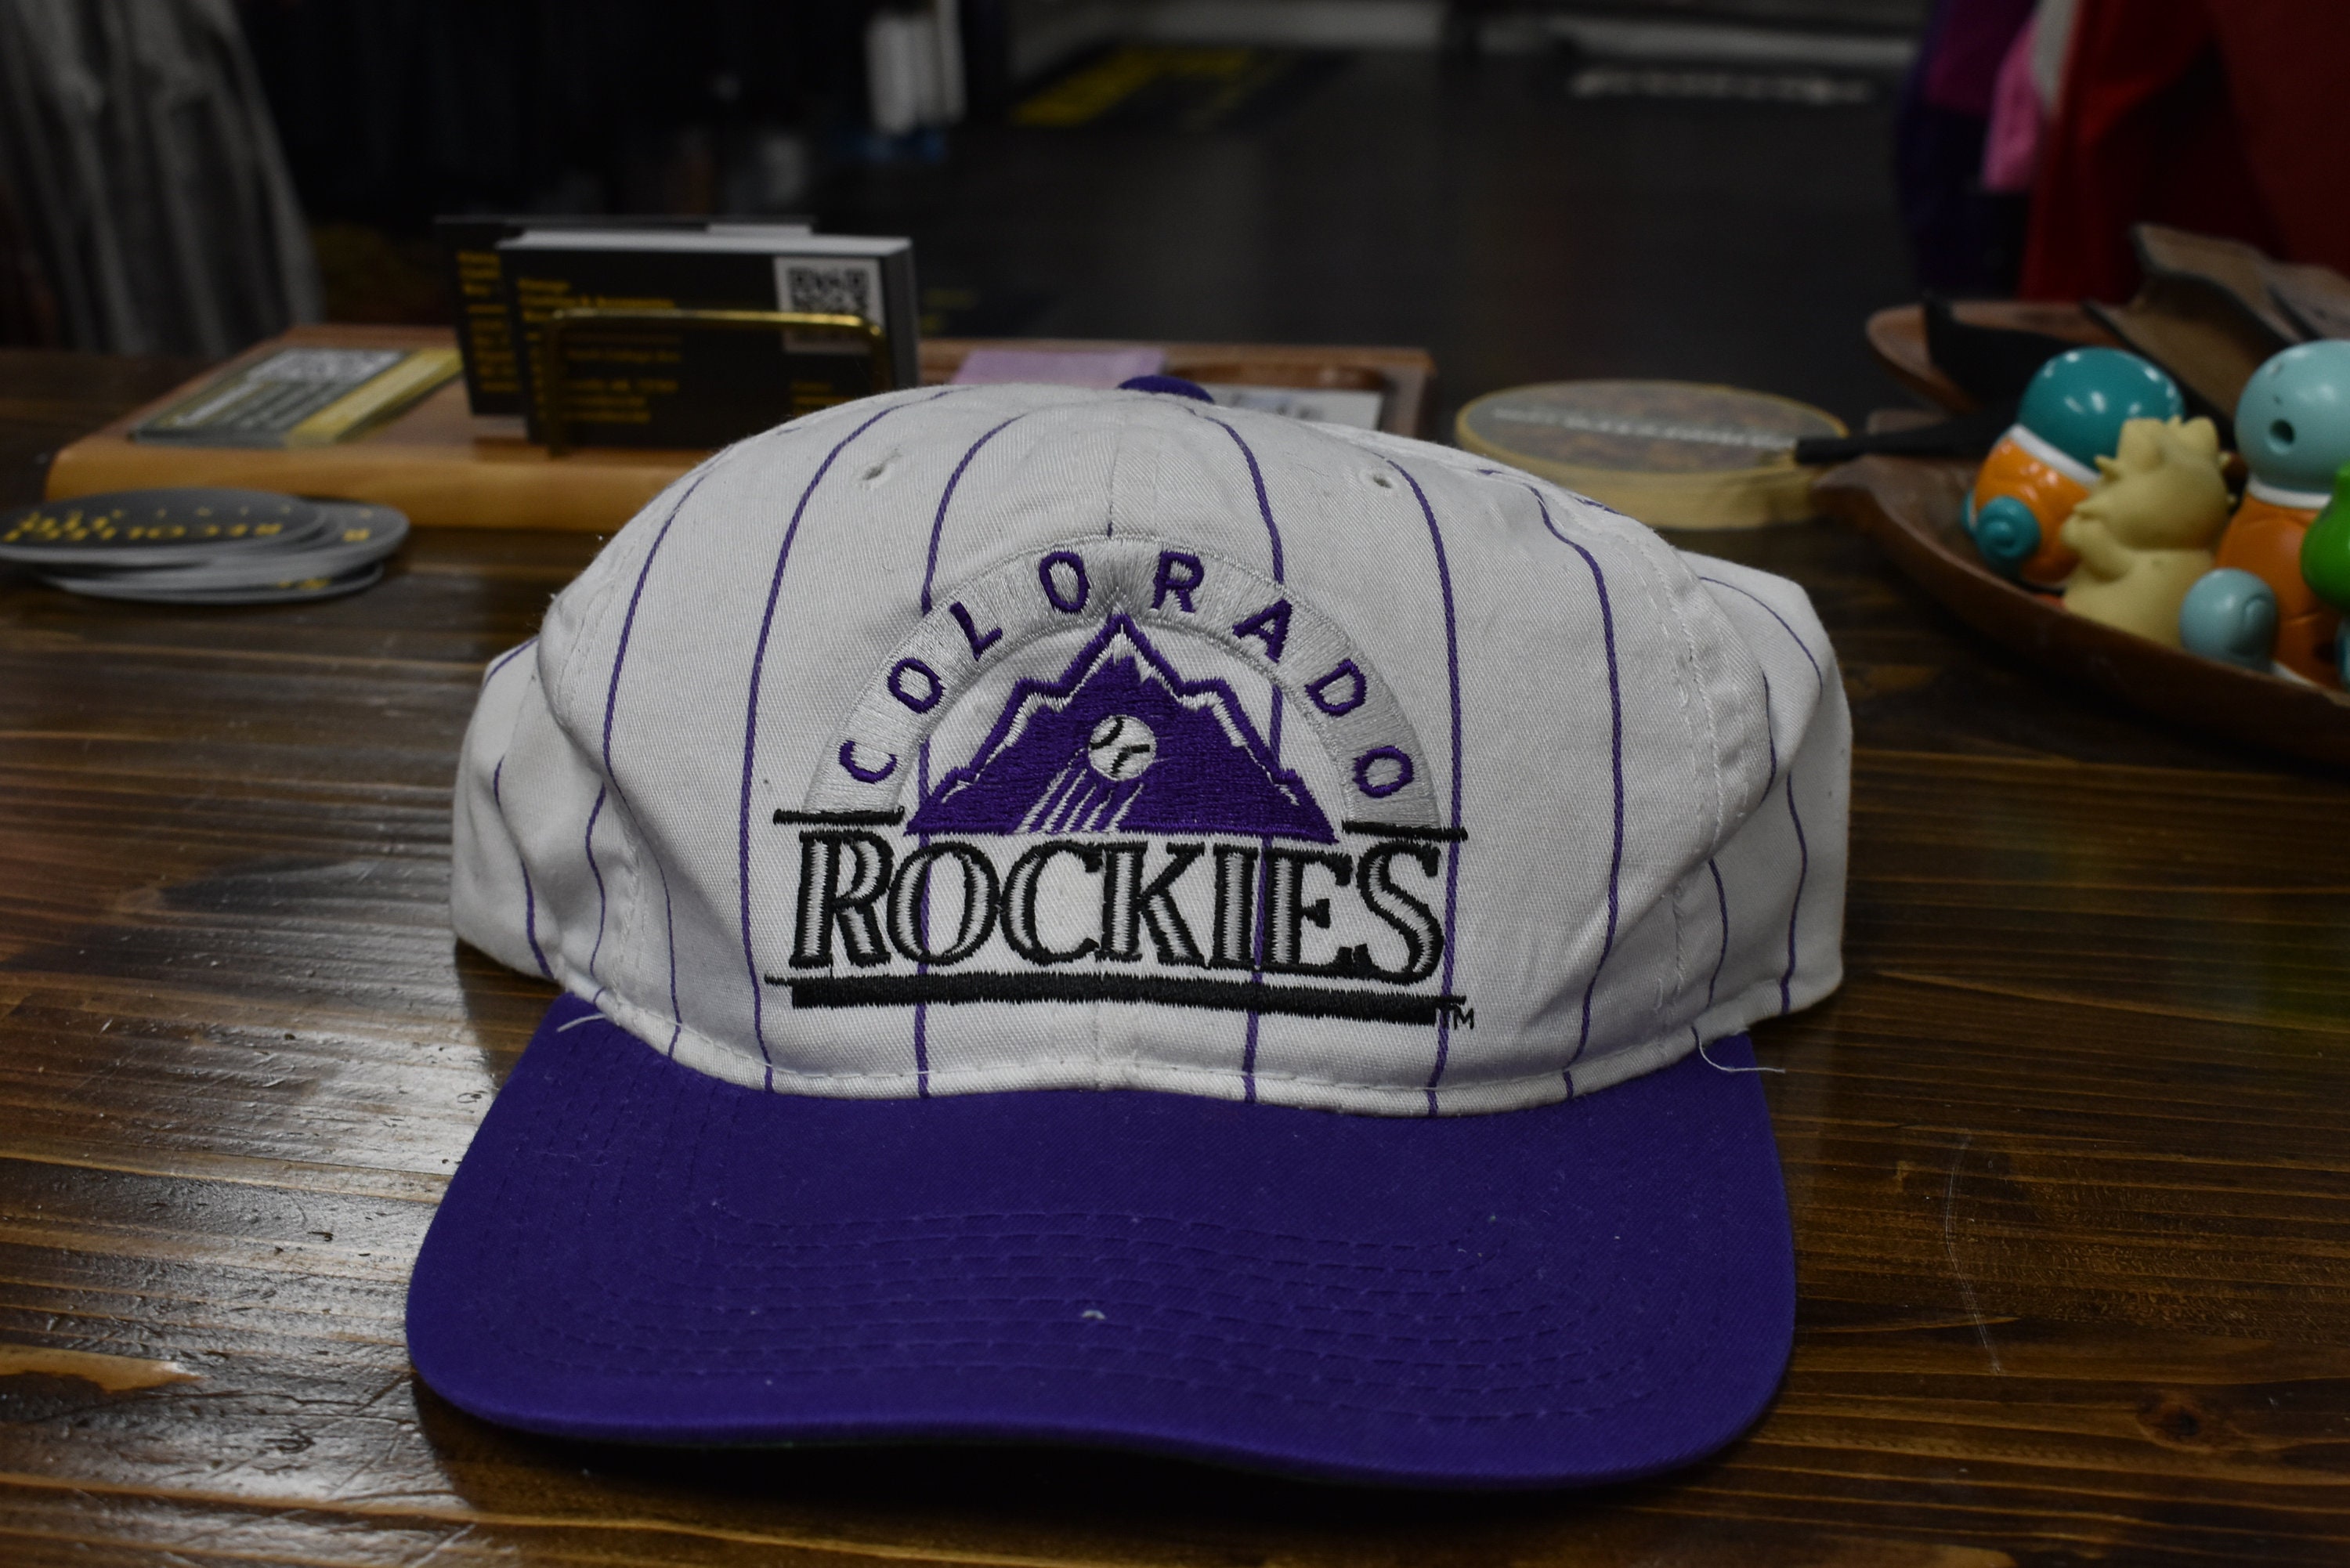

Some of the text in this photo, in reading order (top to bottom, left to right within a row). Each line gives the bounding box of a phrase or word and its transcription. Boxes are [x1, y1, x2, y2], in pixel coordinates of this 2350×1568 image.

[838, 551, 1412, 797] COLORADO
[788, 830, 1444, 985] ROCKIES
[1438, 1003, 1474, 1031] TM
